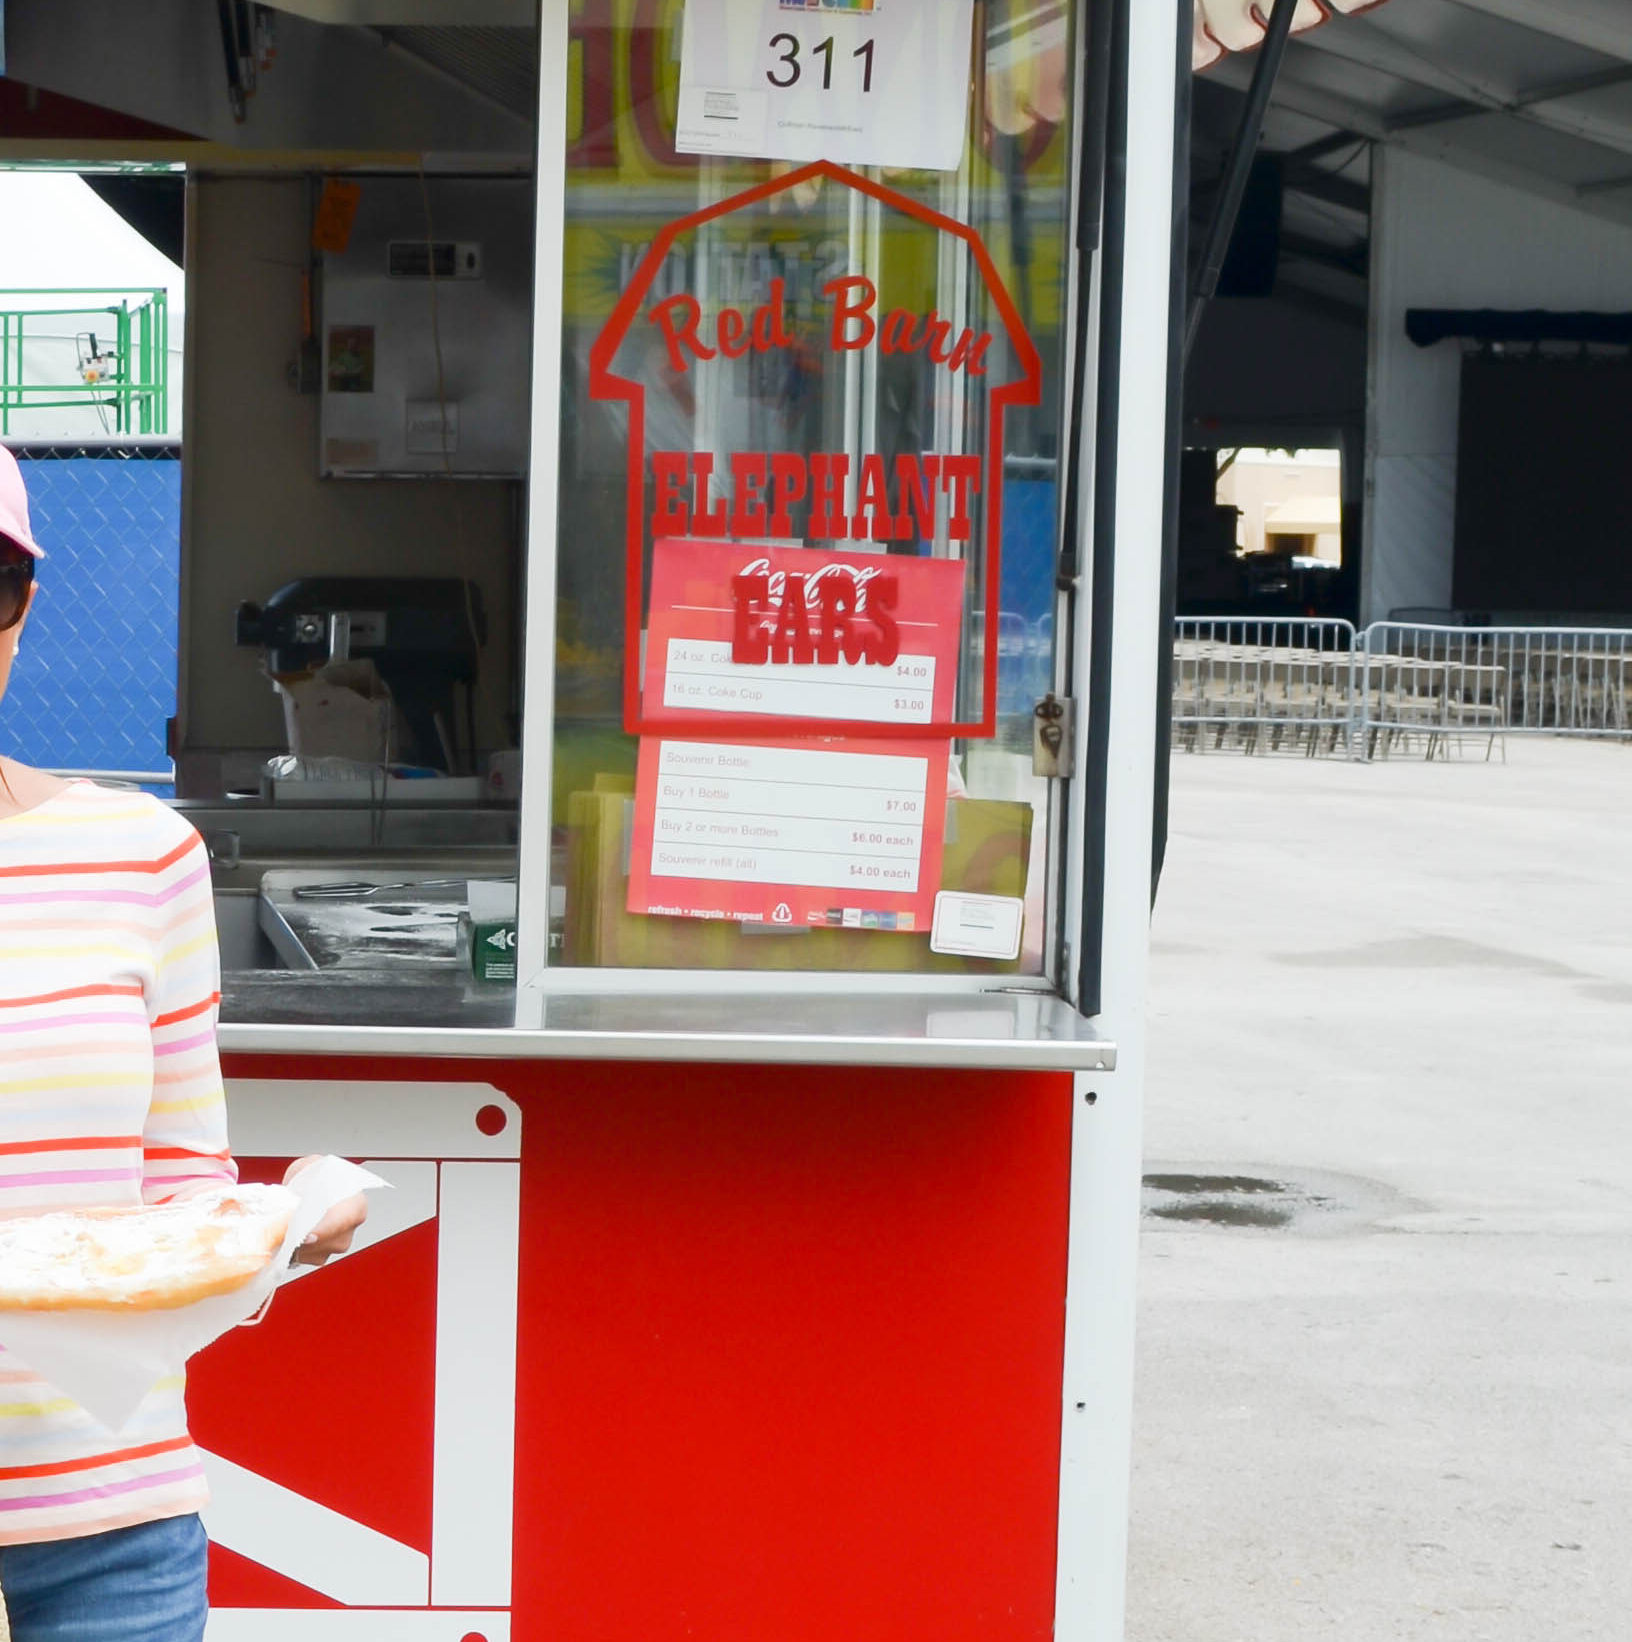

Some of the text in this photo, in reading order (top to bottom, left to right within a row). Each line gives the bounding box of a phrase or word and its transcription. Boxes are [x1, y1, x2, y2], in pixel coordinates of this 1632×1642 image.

[766, 34, 875, 93] 311
[649, 276, 993, 375] Red Barn
[651, 451, 981, 540] ELEPHANT
[732, 575, 899, 667] EARS
[896, 666, 927, 678] $4.00
[894, 699, 924, 711] $3.00
[718, 755, 750, 767] Bottle
[663, 785, 685, 798] Buy
[698, 788, 729, 800] Bottle
[886, 800, 917, 812] $7.00
[661, 819, 914, 846] Buy 2 or more Bottles $6.00 each
[709, 855, 732, 869] refill
[849, 865, 880, 878] $4.00
[883, 868, 911, 879] each
[648, 904, 682, 916] refresh
